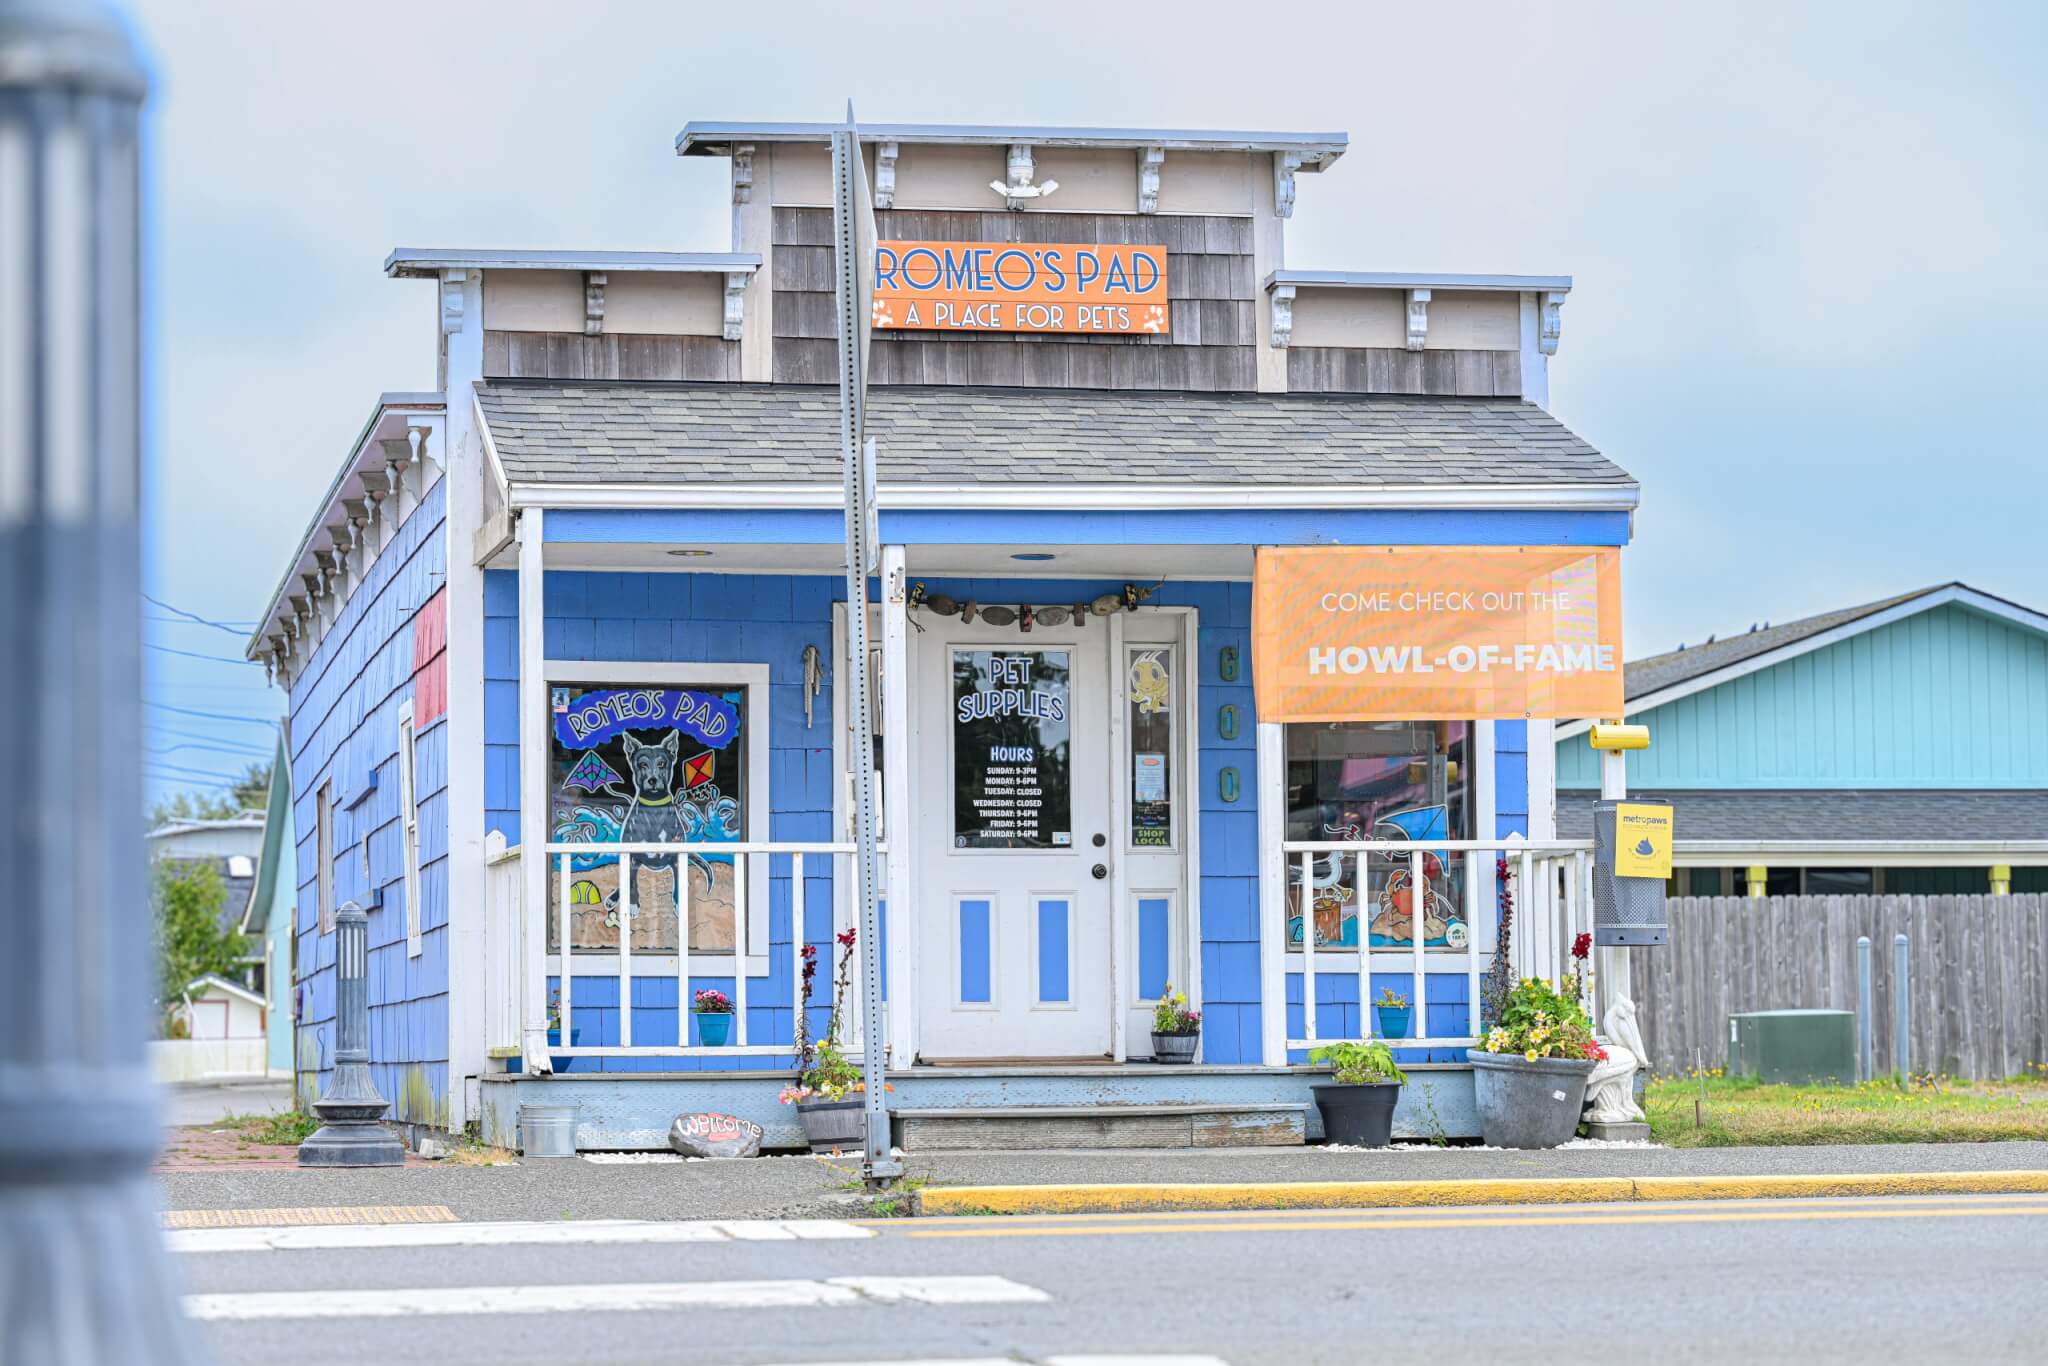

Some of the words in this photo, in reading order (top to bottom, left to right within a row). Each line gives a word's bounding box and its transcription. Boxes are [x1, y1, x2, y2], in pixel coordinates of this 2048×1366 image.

[875, 247, 1067, 292] ROMEO'S
[1076, 251, 1160, 295] PAD
[905, 302, 922, 326] A
[934, 302, 1001, 328] PLACE
[1016, 305, 1064, 329] FOR
[1078, 305, 1130, 330] PETS
[1321, 591, 1391, 612] COME
[1399, 591, 1474, 612] CHECK
[1482, 590, 1524, 611] OUT
[1530, 590, 1571, 611] THE
[1309, 644, 1616, 675] HOWL-OF-FAME
[988, 656, 1033, 684] PET
[959, 690, 1065, 722] SUPPLIES
[567, 690, 665, 741] ROMEO'S
[673, 693, 727, 737] PAD
[990, 745, 1034, 762] HOURS
[986, 767, 1015, 775] SUNDAY:
[985, 777, 1015, 785] MONDAY:
[984, 787, 1015, 795] TUESDAY:
[1016, 788, 1042, 796] CLOSED
[973, 799, 1015, 807] WEDNESDAY:
[1016, 799, 1042, 807] CLOSED
[979, 809, 1015, 817] THURSDAY:
[990, 820, 1015, 828] FRIDAY:
[1623, 815, 1668, 826] metropaws
[980, 830, 1015, 838] SATURDAY:
[1136, 829, 1165, 838] SHOP
[1135, 837, 1168, 845] LOCAL
